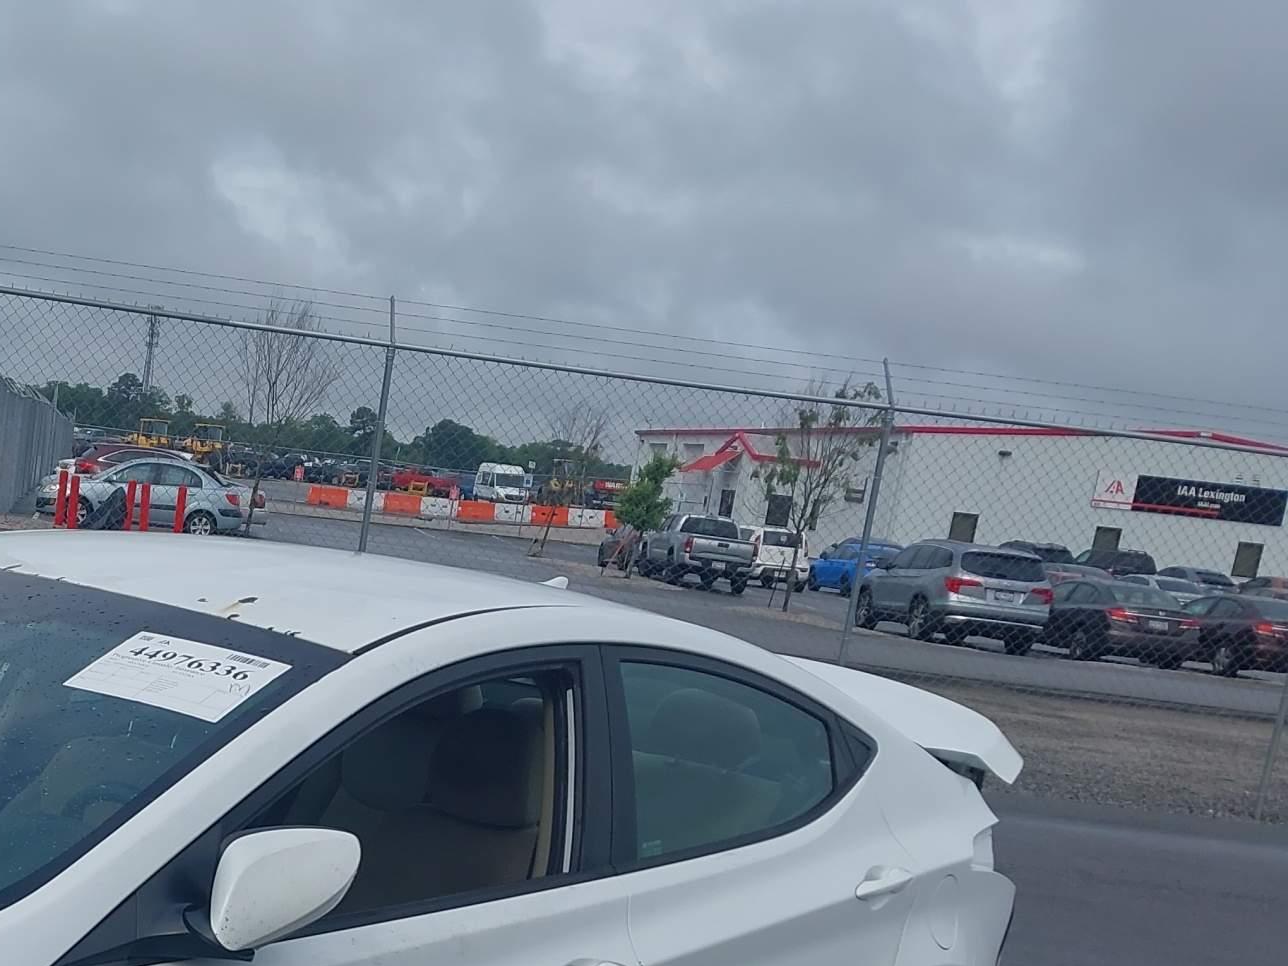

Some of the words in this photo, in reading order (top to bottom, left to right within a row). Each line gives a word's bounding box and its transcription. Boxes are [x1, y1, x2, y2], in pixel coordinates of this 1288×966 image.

[1177, 485, 1196, 497] IAA
[1198, 487, 1246, 503] Lexington
[129, 646, 255, 681] 44976336
